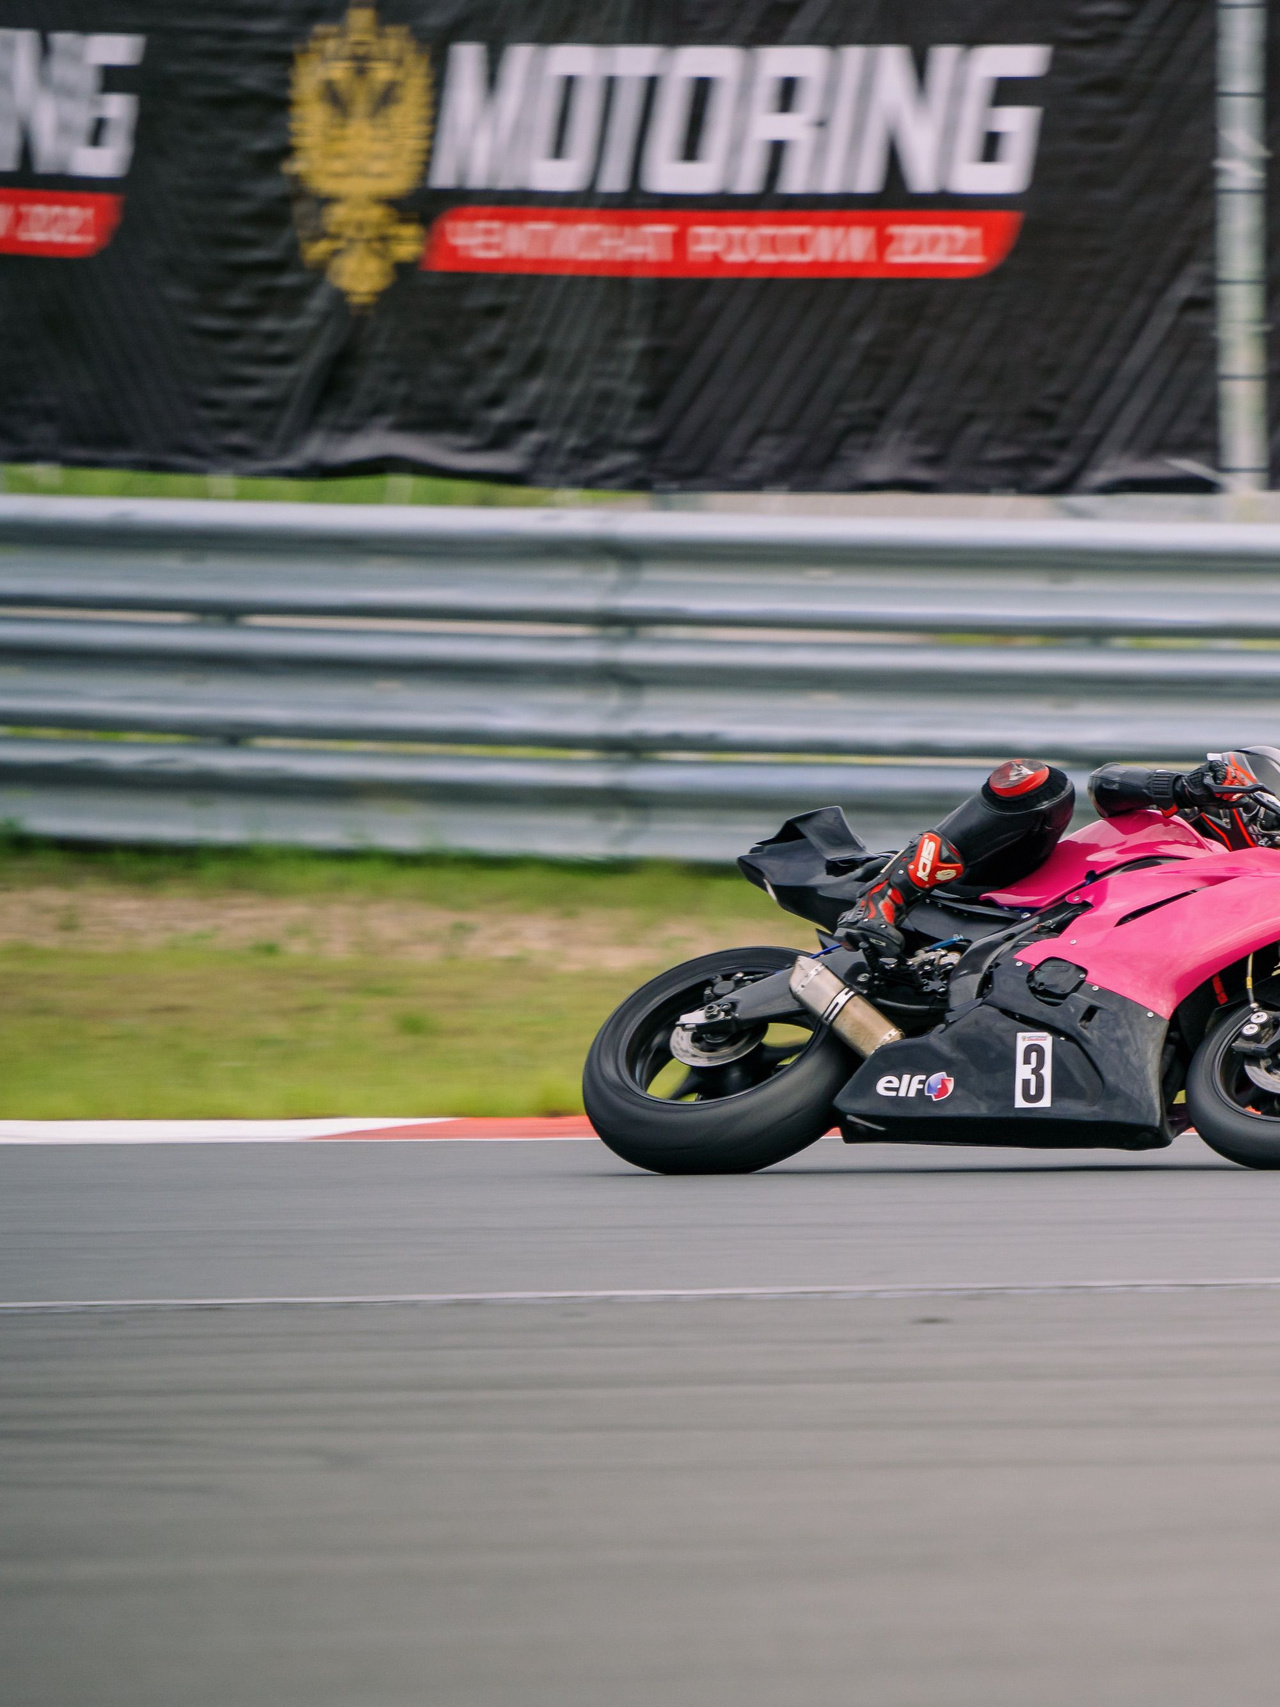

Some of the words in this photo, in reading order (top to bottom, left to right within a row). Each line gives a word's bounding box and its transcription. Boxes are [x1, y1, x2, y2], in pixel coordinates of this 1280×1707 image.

[428, 42, 1053, 194] MOTORING
[687, 225, 878, 263] РОССИИ
[884, 225, 986, 264] 2021
[876, 1074, 927, 1097] elf
[1021, 1043, 1046, 1103] 3
